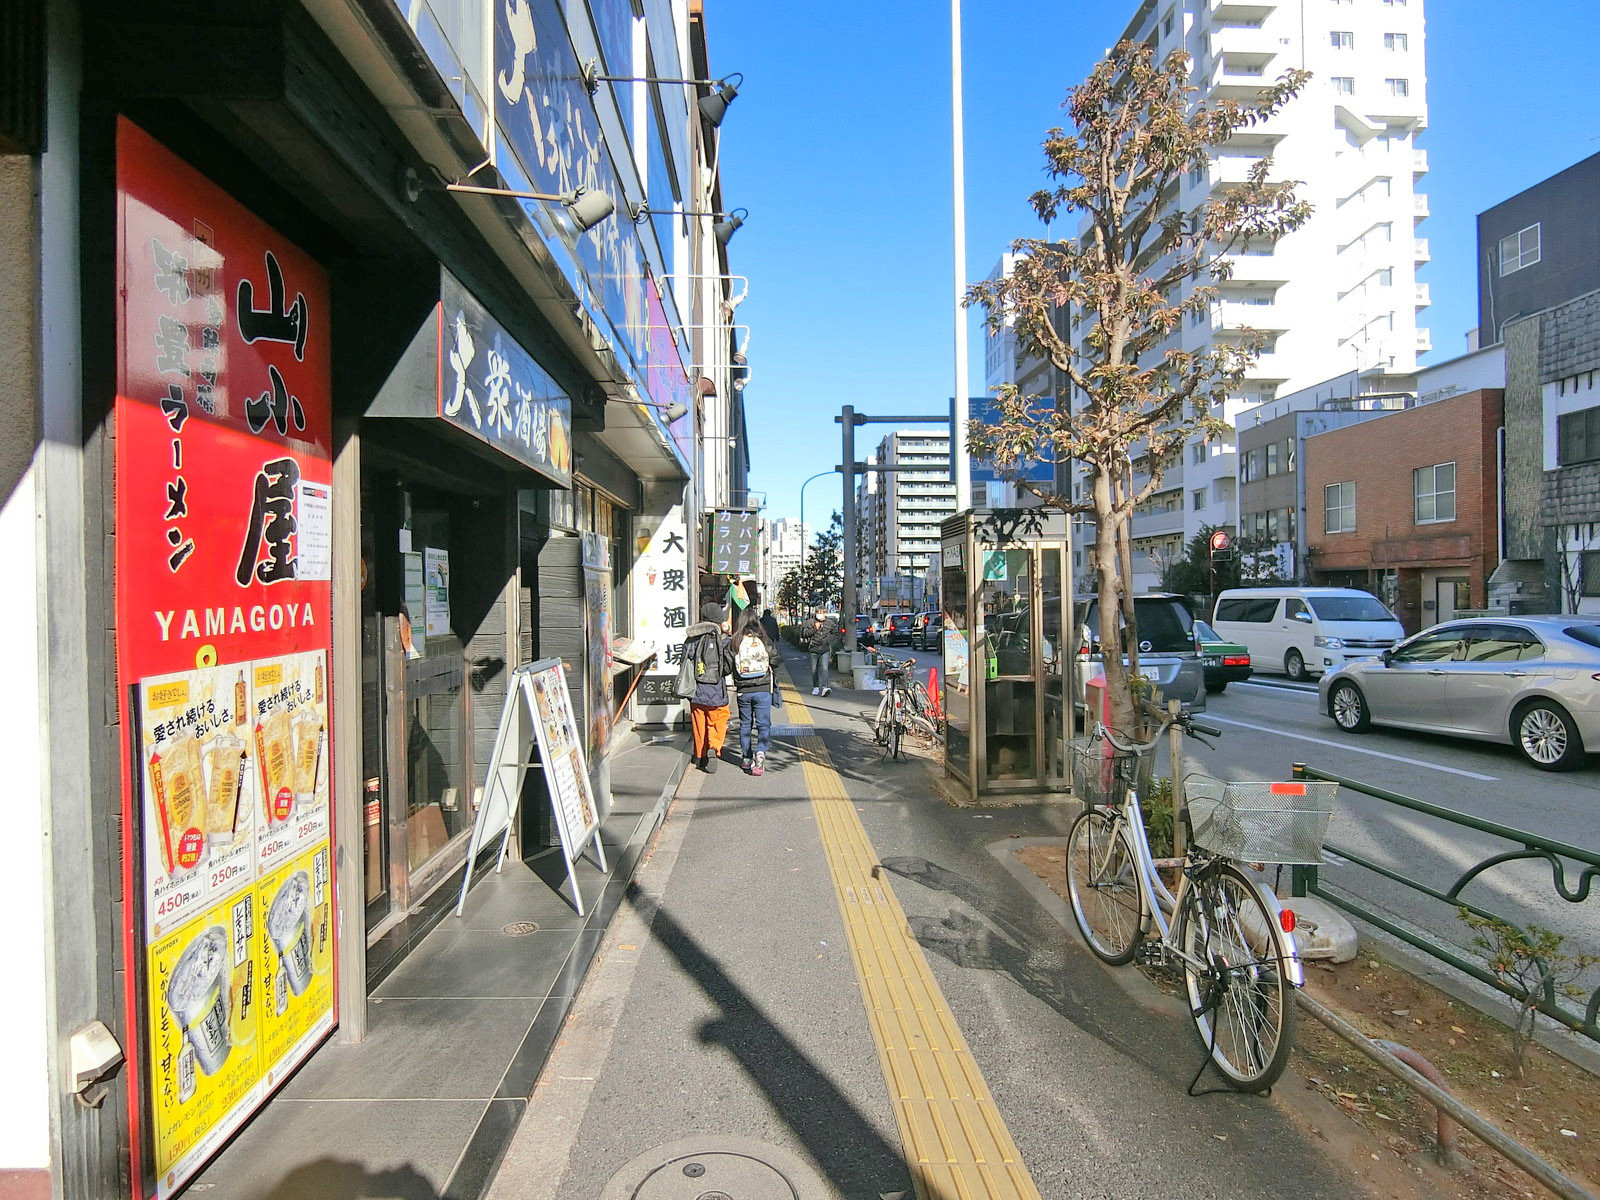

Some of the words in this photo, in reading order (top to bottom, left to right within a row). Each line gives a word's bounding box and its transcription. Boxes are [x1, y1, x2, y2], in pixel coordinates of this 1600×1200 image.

[445, 310, 547, 463] 大衆酒場
[235, 250, 310, 588] 山小屋
[719, 509, 732, 572] カラバフ
[738, 510, 752, 573] ケバブ屋
[662, 531, 686, 667] 大衆酒場
[154, 602, 315, 642] YAMAGOYA
[257, 680, 301, 715] 愛され続ける
[286, 688, 315, 713] おいしさ。
[153, 699, 215, 744] 愛され続ける
[195, 709, 234, 739] おいしさ。
[155, 938, 179, 955] SUNTORY
